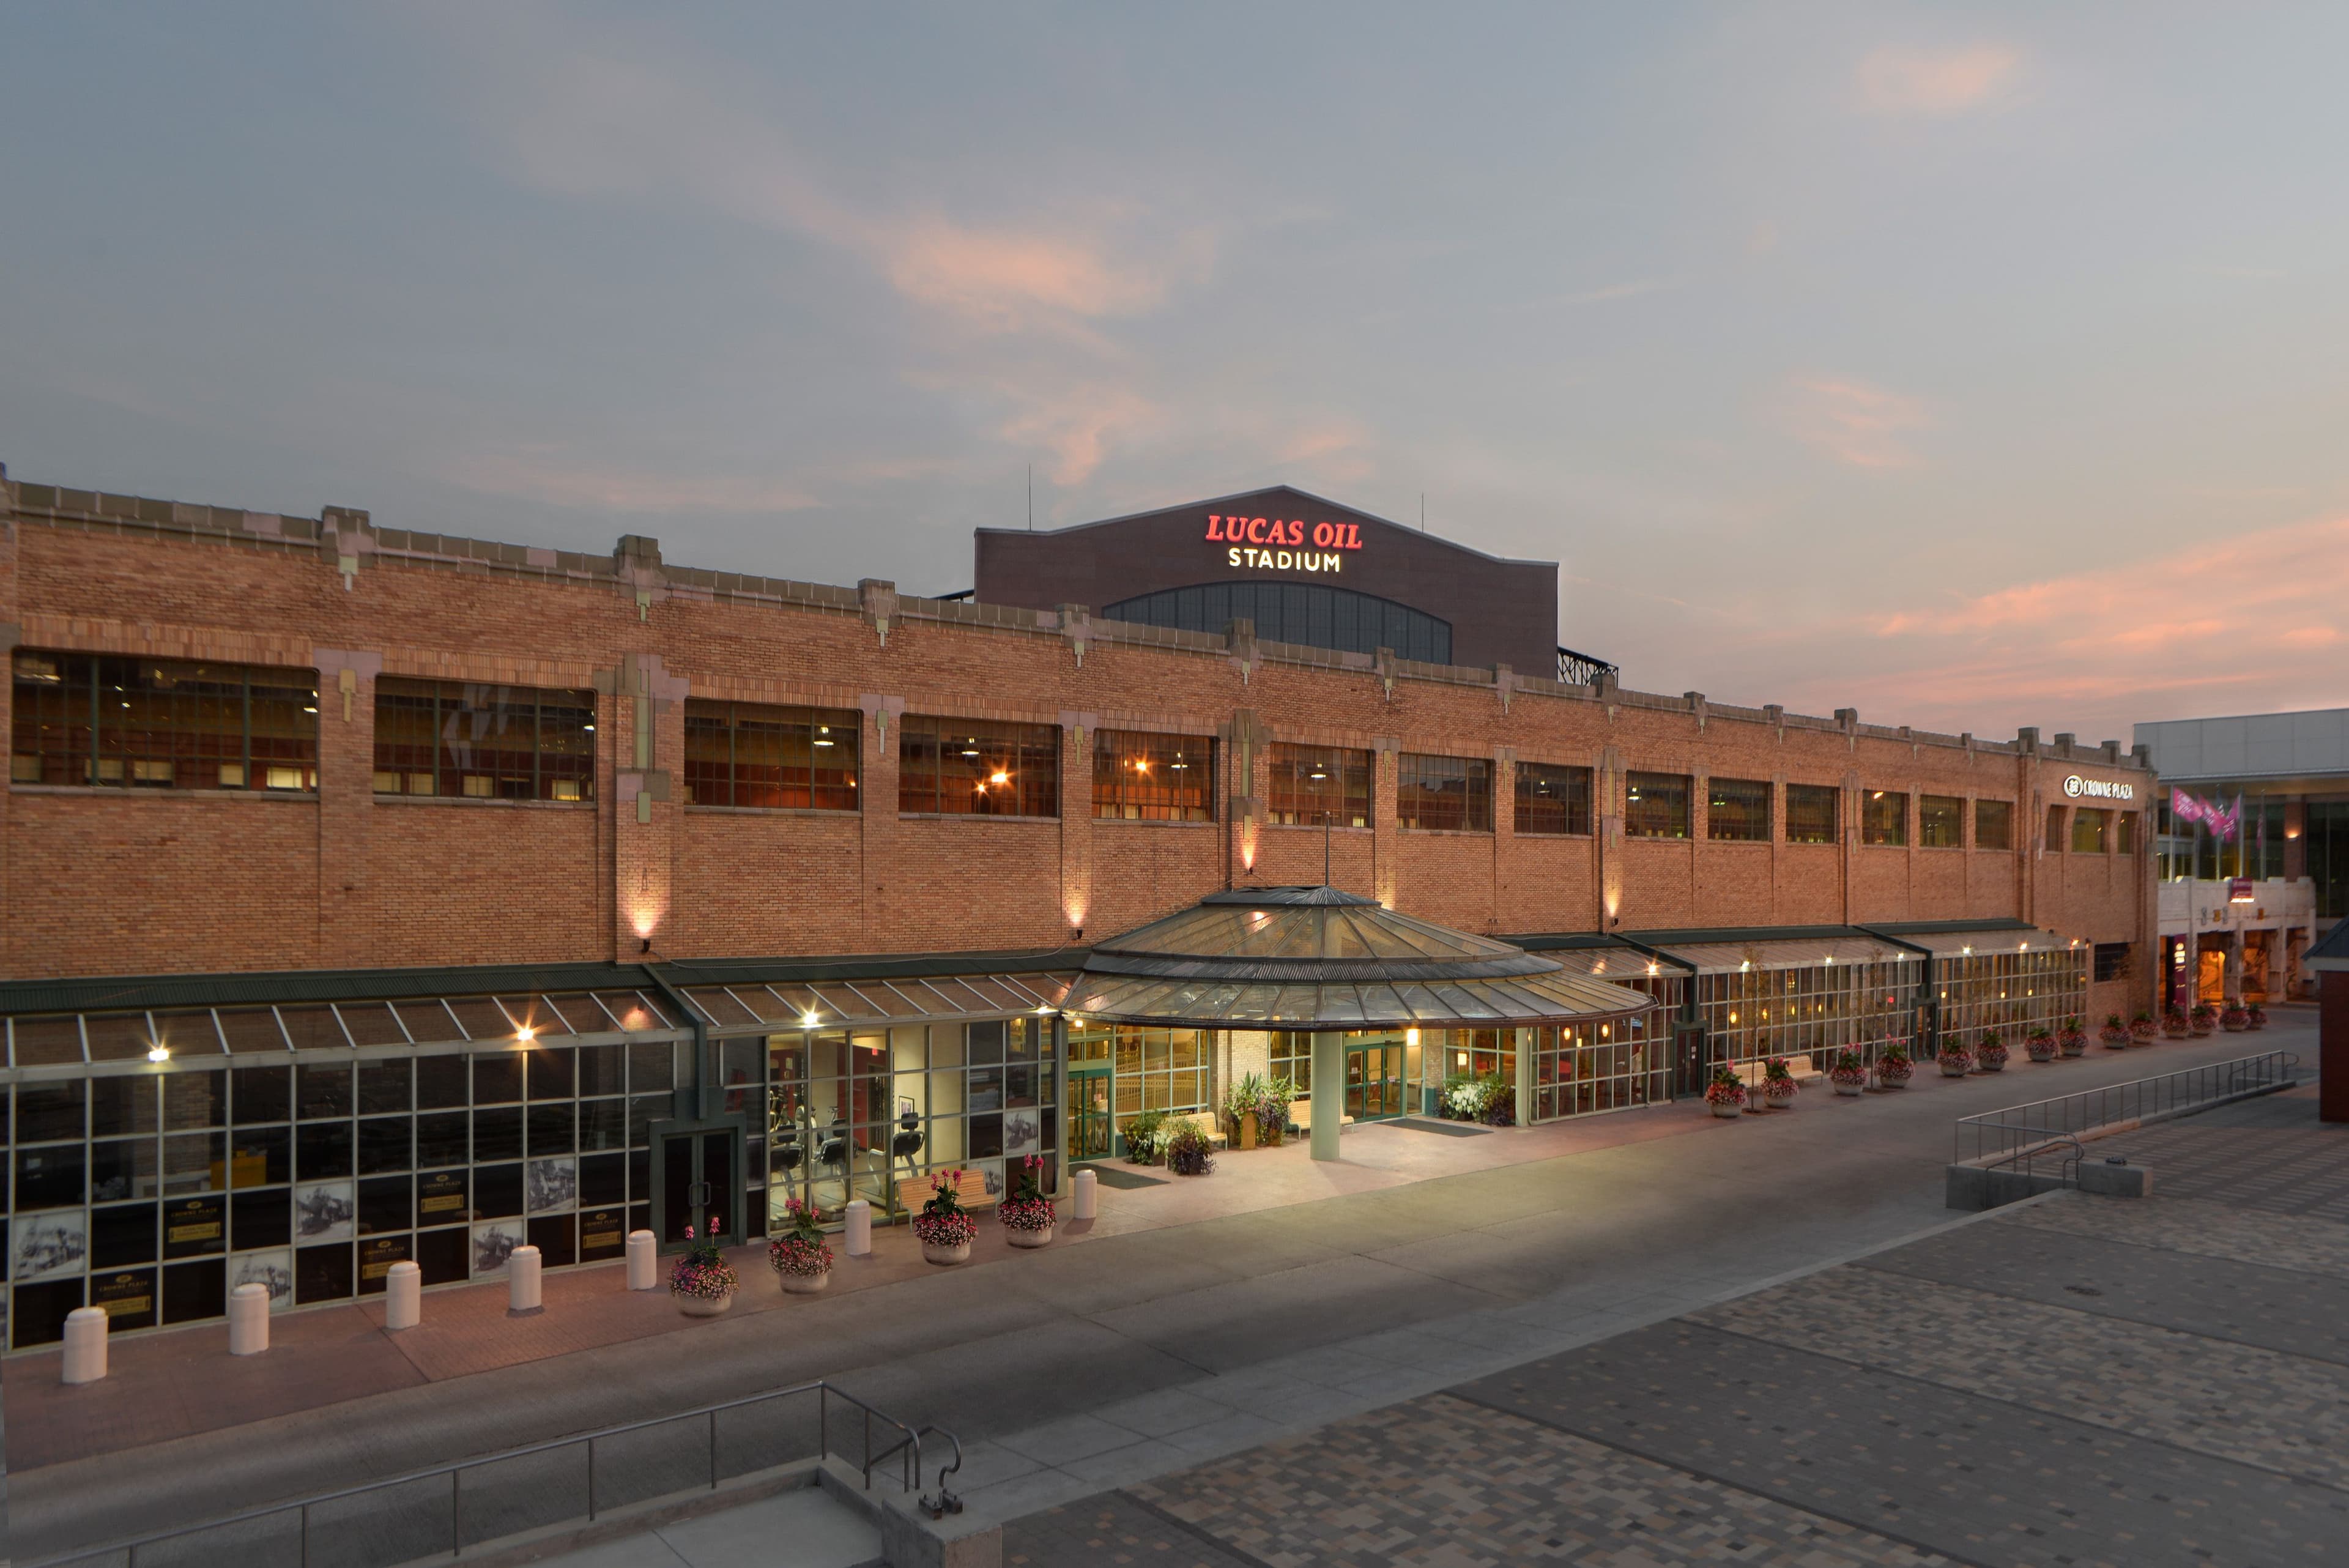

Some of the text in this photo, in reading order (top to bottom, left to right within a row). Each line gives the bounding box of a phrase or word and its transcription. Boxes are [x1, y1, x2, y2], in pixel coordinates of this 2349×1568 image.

[1206, 515, 1362, 549] LUCAS OIL
[1229, 548, 1340, 572] STADIUM
[2084, 779, 2133, 799] CROWNE PLAZA
